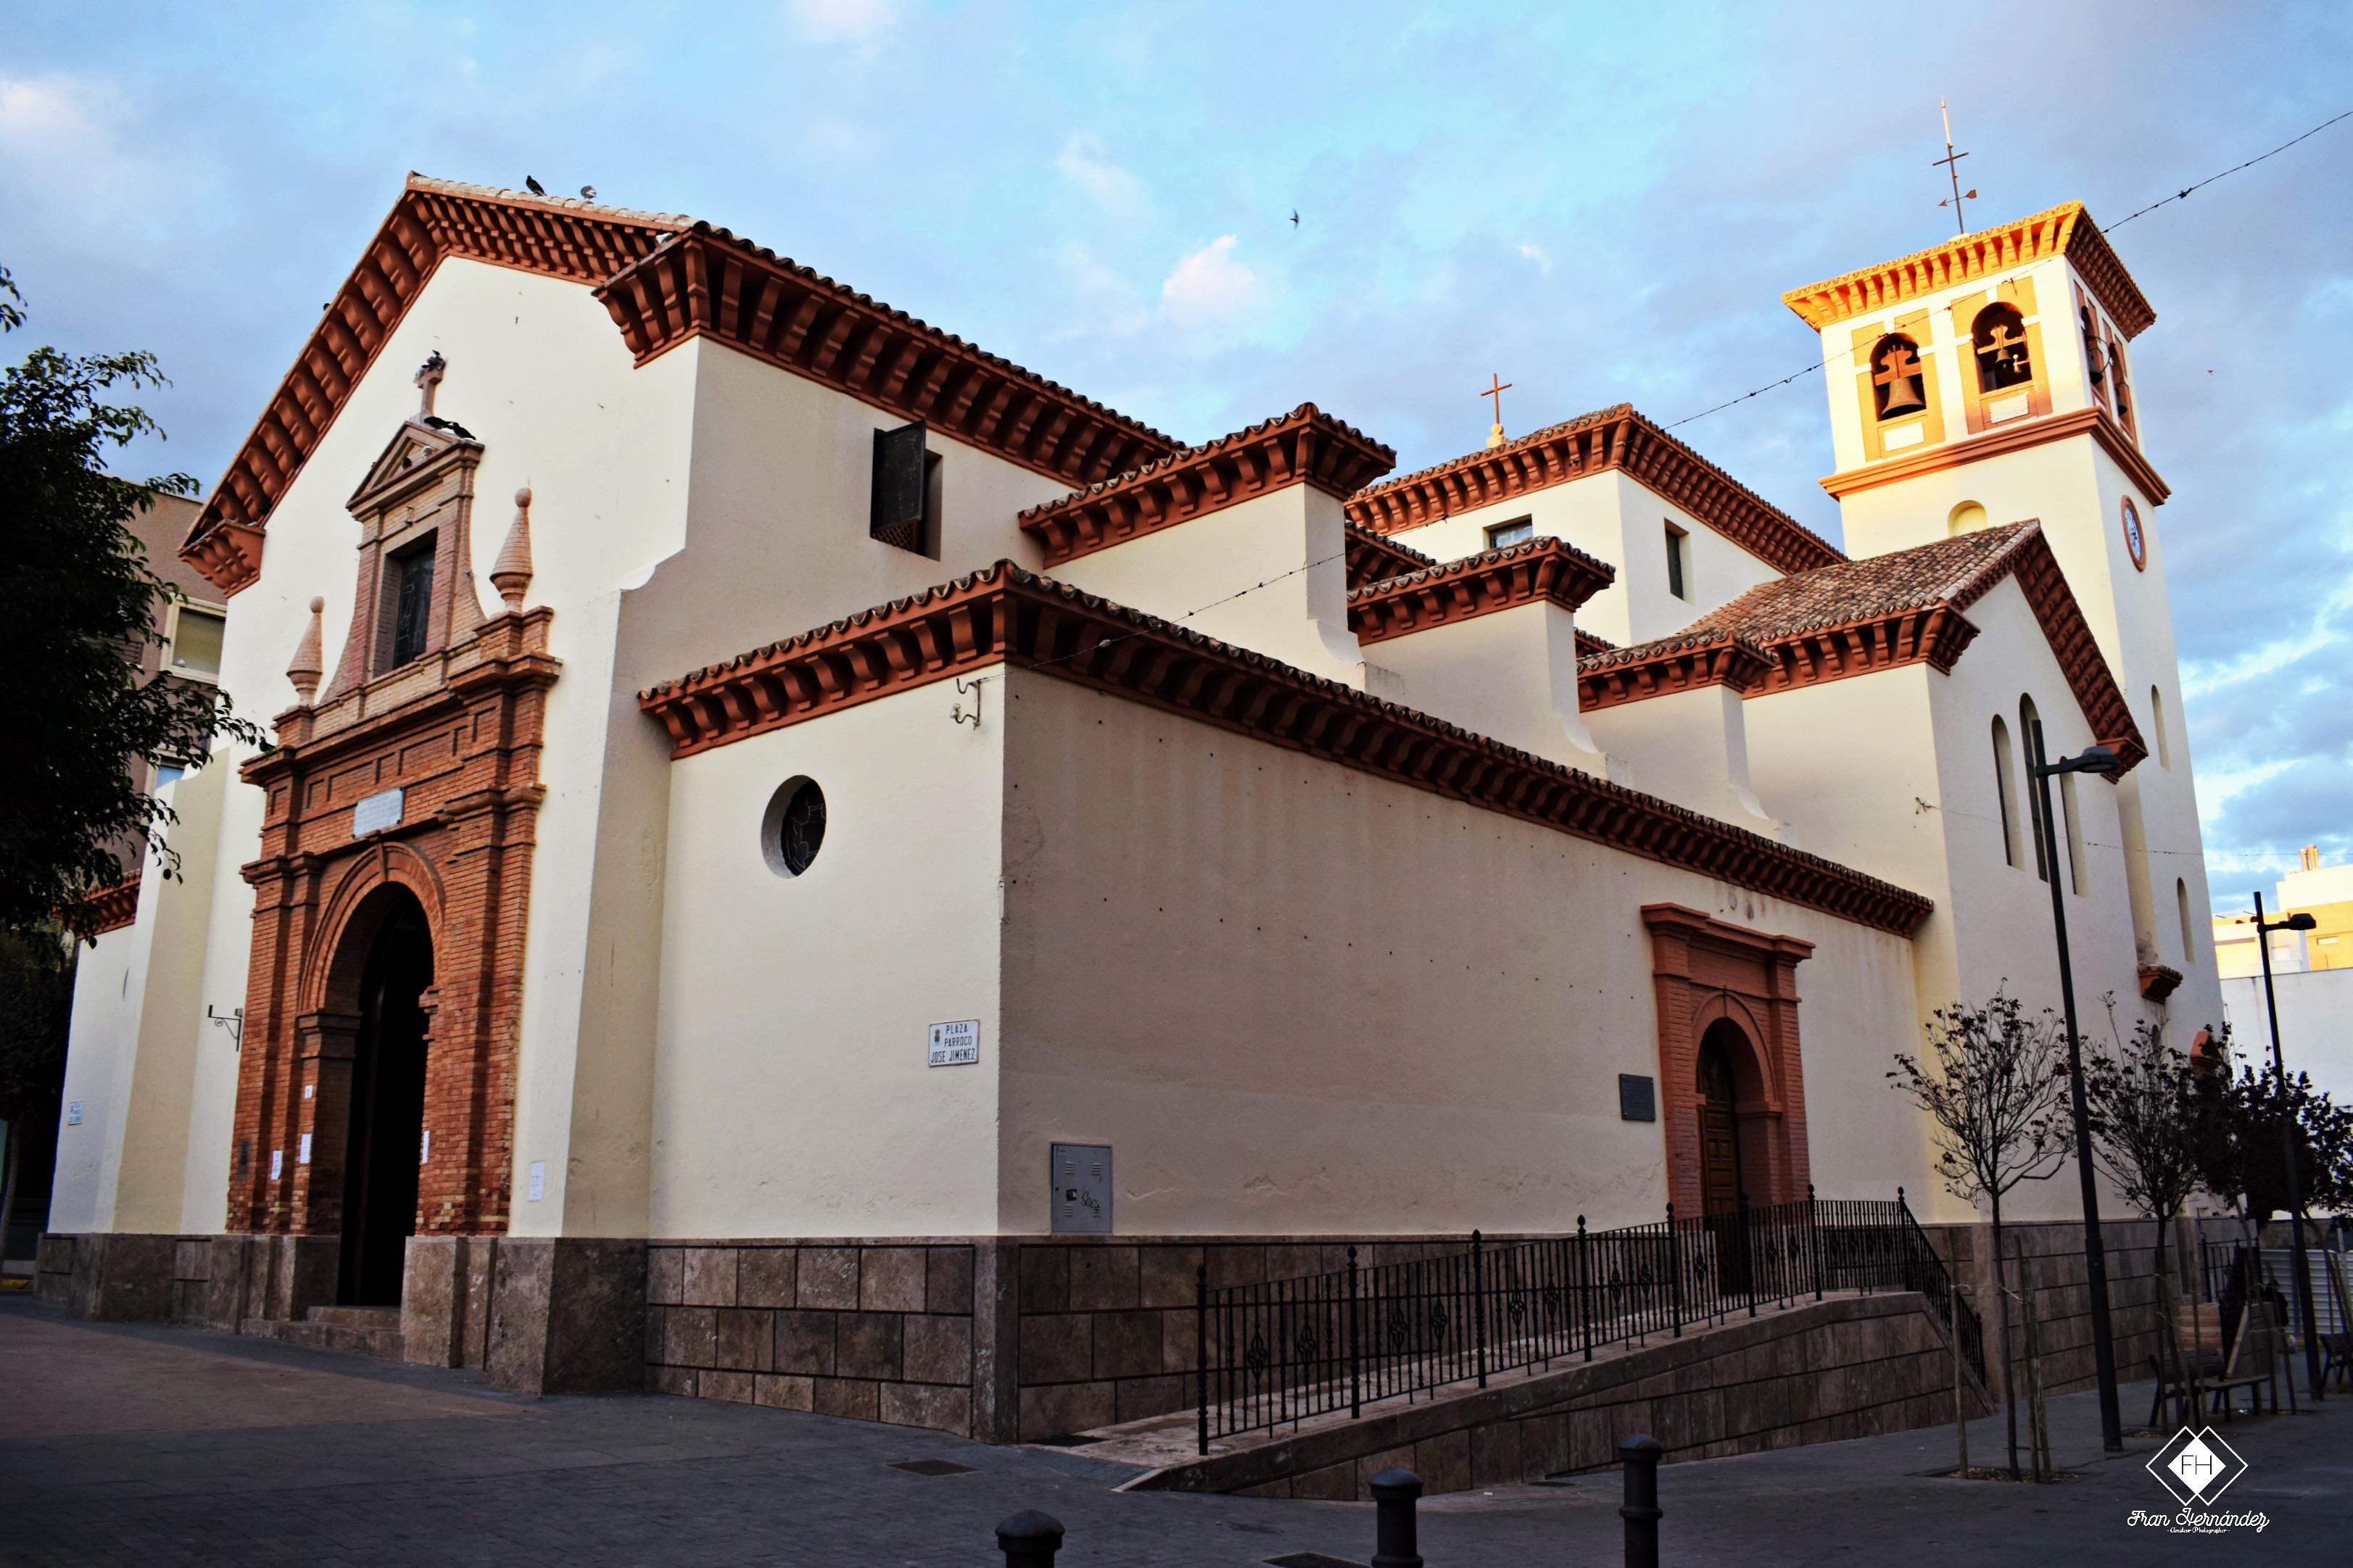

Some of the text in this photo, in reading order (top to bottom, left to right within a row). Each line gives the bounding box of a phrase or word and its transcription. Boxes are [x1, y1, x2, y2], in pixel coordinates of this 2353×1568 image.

[946, 1024, 967, 1034] PLAZA
[944, 1036, 972, 1048] PARROCO
[931, 1048, 975, 1063] JOSE JIMENEZ
